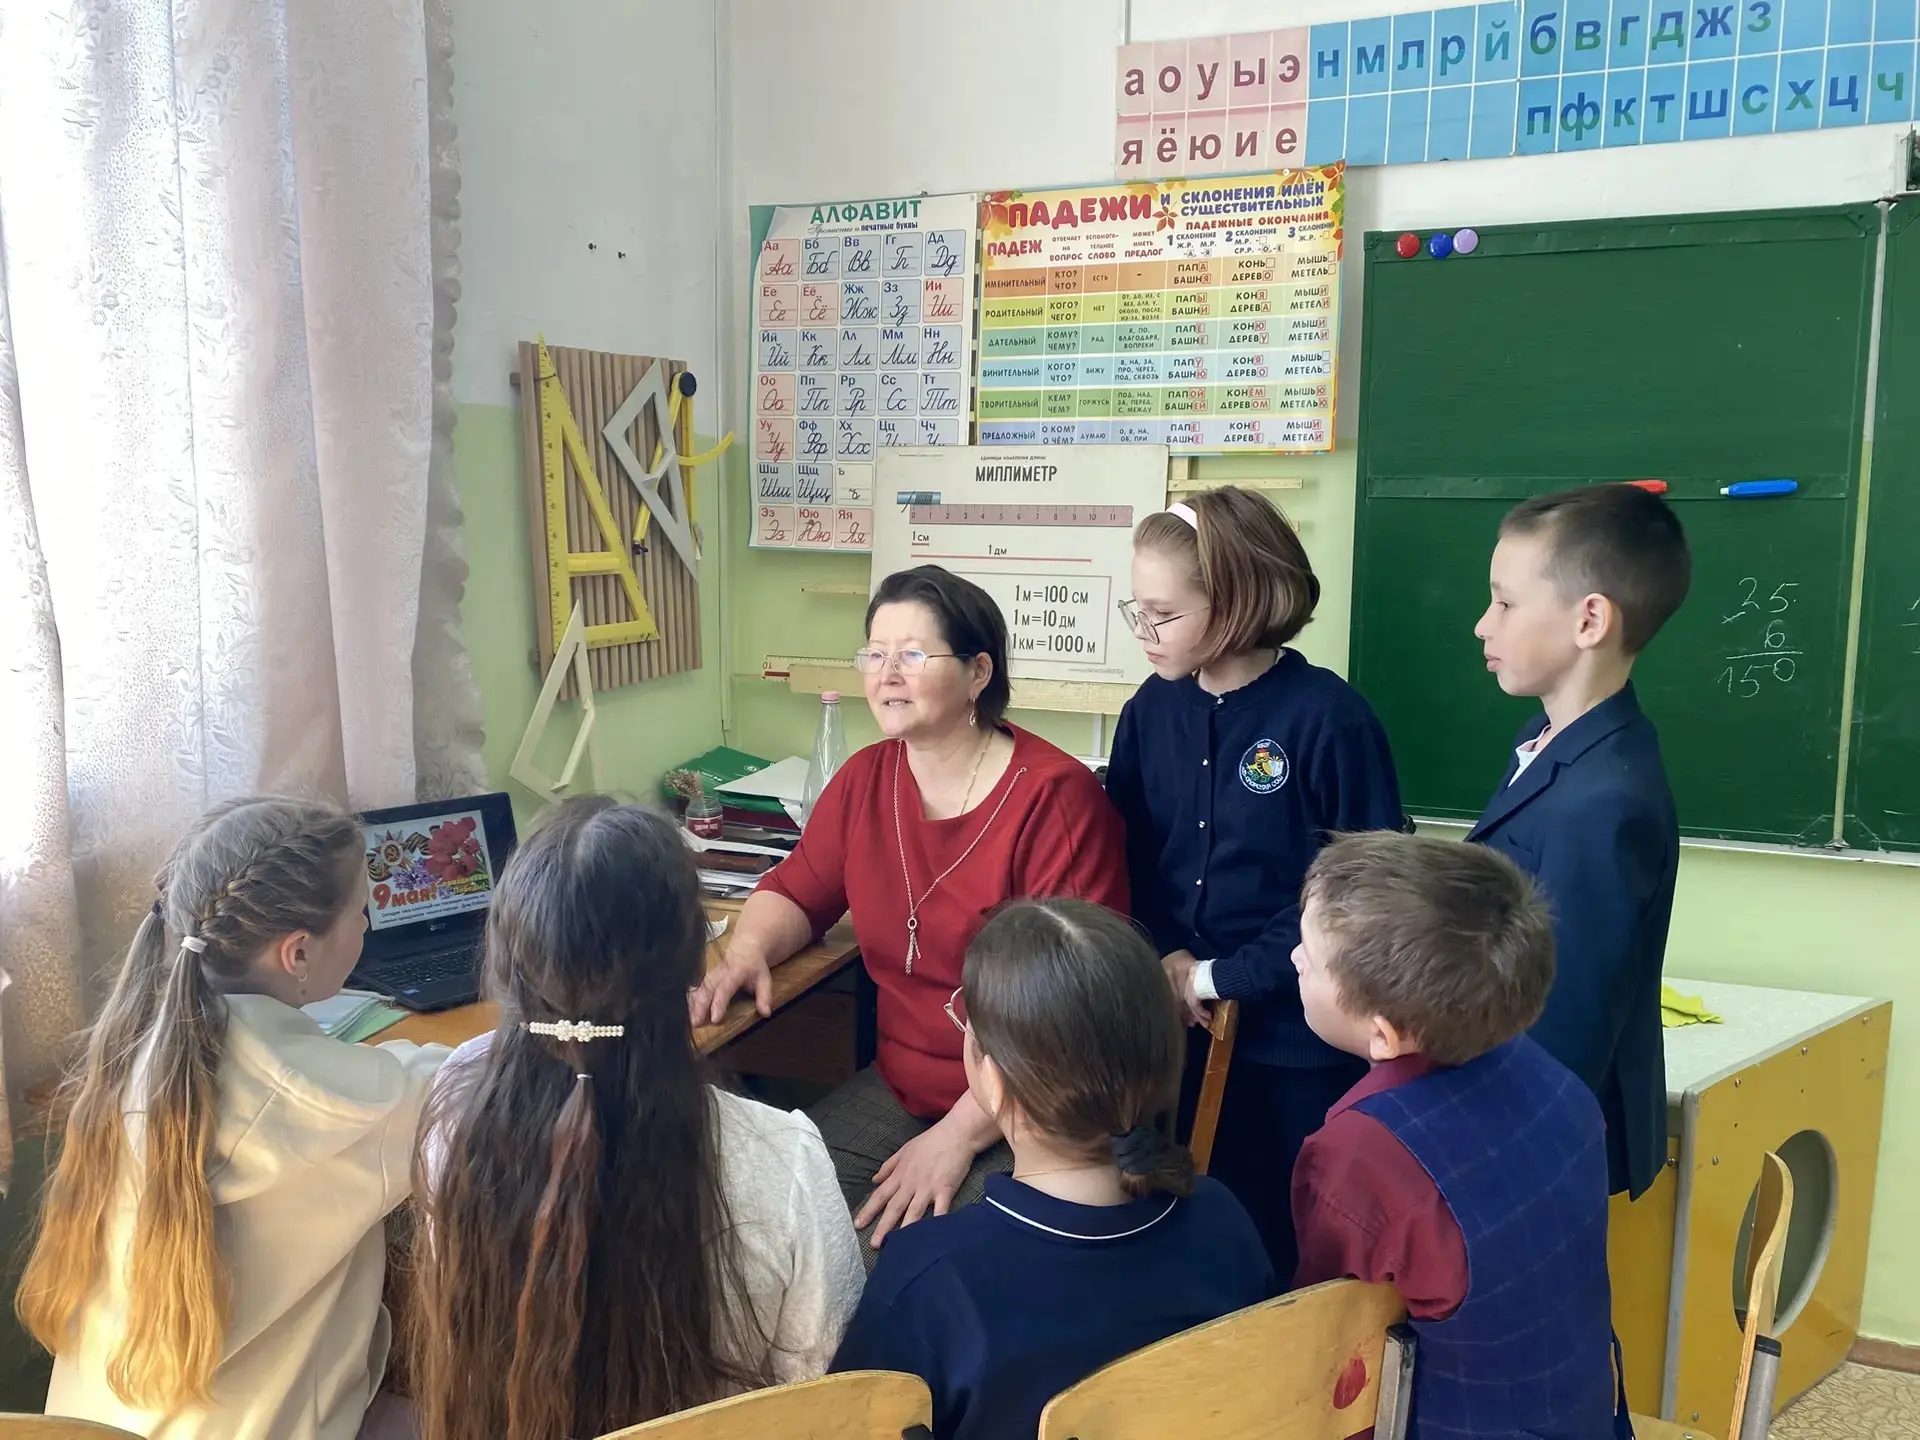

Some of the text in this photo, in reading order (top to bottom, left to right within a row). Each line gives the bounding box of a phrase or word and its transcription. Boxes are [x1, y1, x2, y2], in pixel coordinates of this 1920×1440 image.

[1530, 12, 1557, 54] б
[1575, 20, 1601, 50] в
[1620, 16, 1640, 46] г
[1652, 10, 1684, 50] д
[1694, 5, 1734, 38] ж
[1124, 20, 1510, 100] а о у ы э н м л р й
[1527, 72, 1904, 140] п ф к т ш с х ц ч
[1121, 128, 1297, 165] я ё ю и е
[1161, 193, 1170, 205] И
[1181, 186, 1275, 204] СКЛОНЕНИЯ
[1181, 196, 1323, 216] СУЩЕСТВИТЕЛЬНЫХ
[810, 200, 922, 224] АЛФАВИТ
[1008, 194, 1151, 230] ПАДЕЖИ
[861, 223, 894, 231] печатные
[896, 221, 918, 230] буквы
[1186, 211, 1329, 231] ПАДЕЖНЫЕ ОКОНЧАНИЯ
[987, 239, 1042, 257] ПАДЕЖ
[1125, 248, 1163, 258] ПРЕДЛОГ
[1050, 253, 1083, 262] ВОПРОС
[1088, 252, 1116, 260] СЛОВО
[1297, 256, 1328, 265] МЫШЬ
[1178, 262, 1207, 272] ПАПА
[1239, 260, 1266, 268] КОНЬ
[1055, 270, 1077, 278] КТО?
[1232, 271, 1272, 281] ДЕРЕВО
[1291, 268, 1328, 278] МЕТЕЛЬ
[985, 278, 1045, 288] ИМЕНИТЕЛЬНЫЙ
[1174, 274, 1210, 284] БАШНЯ
[1055, 282, 1077, 290] ЧТО?
[1294, 285, 1328, 297] МЫШИ
[1236, 290, 1267, 300] КОНЯ
[1050, 301, 1078, 310] КОГО?
[1230, 303, 1270, 312] ДЕРЕВА
[1290, 298, 1330, 310] МЕТЕЛИ
[985, 307, 1043, 318] РОДИТЕЛЬНЫЙ
[1172, 306, 1209, 315] БАШНИ
[1051, 313, 1077, 321] ЧЕГО?
[1048, 331, 1078, 339] КОМУ?
[989, 338, 1036, 347] ДАТЕЛЬНЫЙ
[1048, 342, 1076, 351] ЧЕМУ?
[1048, 362, 1075, 371] КОГО?
[983, 367, 1039, 377] ВИНИТЕЛЬНЫЙ
[1168, 388, 1205, 399] ПАПОЙ
[1284, 386, 1327, 397] МЫШЬЮ
[982, 398, 1038, 408] ТВОРИТЕЛЬНЫЙ
[1048, 394, 1070, 402] КЕМ?
[1280, 398, 1328, 408] МЕТЕЛЬЮ
[1165, 400, 1208, 411] БАШНЕЙ
[1220, 400, 1270, 410] ДЕРЕВОМ
[982, 430, 1035, 440] ПРЕДЛОЖНЫЙ
[976, 465, 1057, 482] МИЛЛИМЕТР
[1764, 620, 1785, 648] 6
[372, 884, 390, 910] 9
